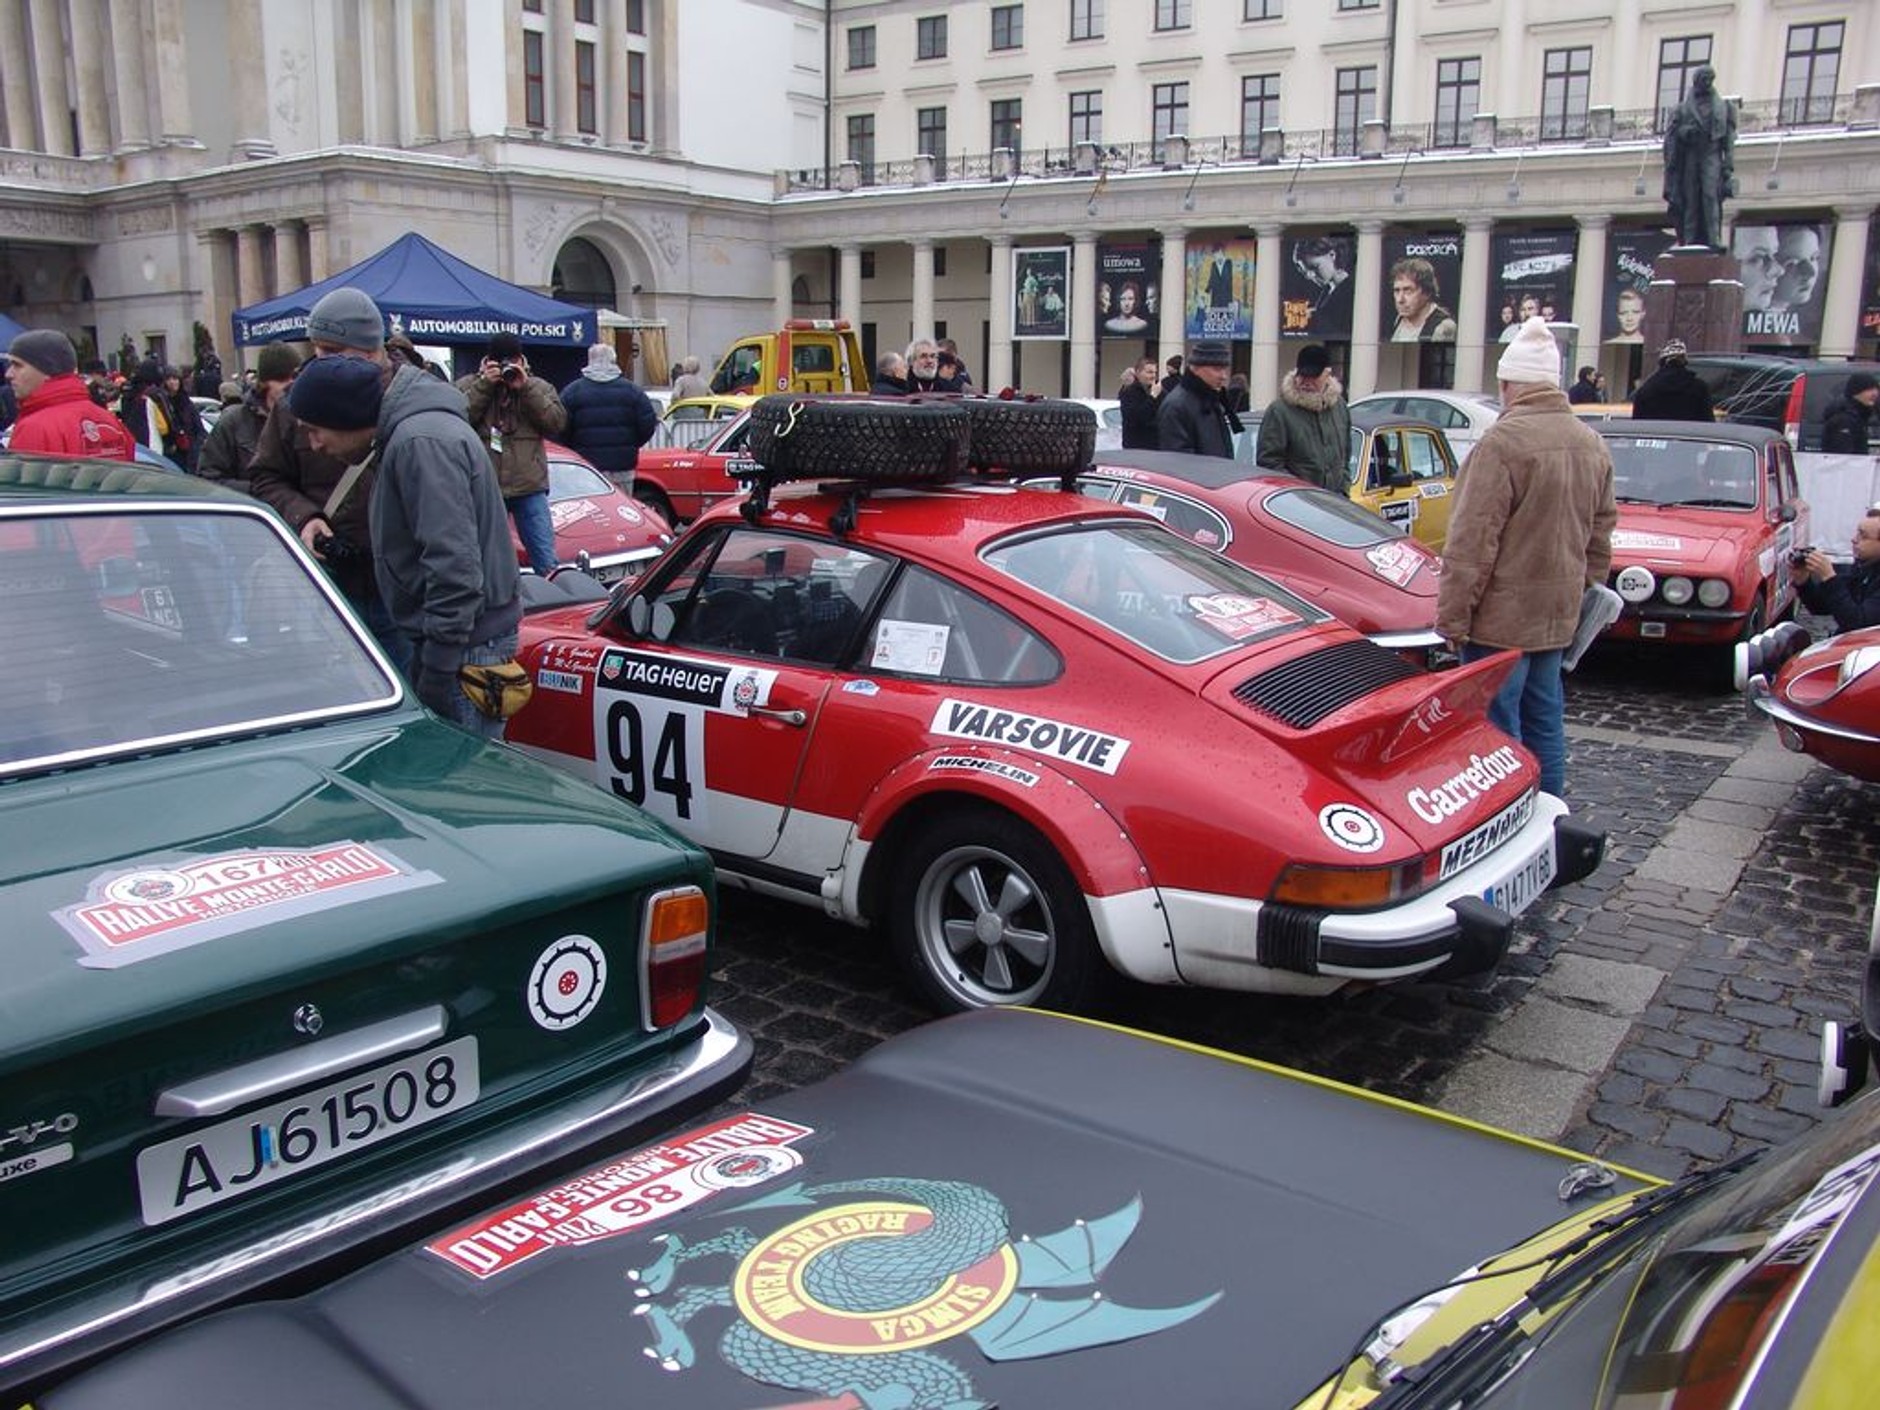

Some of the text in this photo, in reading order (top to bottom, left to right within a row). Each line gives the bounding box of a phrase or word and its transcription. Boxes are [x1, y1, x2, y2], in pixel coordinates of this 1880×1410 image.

[251, 315, 313, 337] AUTOMOBILKL
[409, 319, 566, 338] AUTOMOBILKLUB POLSKI
[1747, 312, 1800, 335] MEWA
[607, 699, 693, 821] 94
[948, 703, 1116, 767] VARSOVIE
[933, 757, 1034, 784] MICHELIN
[1406, 745, 1523, 825] Carrefour
[91, 848, 379, 937] RALLYE MONTE-CARLO
[196, 859, 267, 886] 167
[174, 1054, 457, 1207] AJ 61508
[448, 1117, 796, 1272] RALLYE MONTE-CARLO
[536, 1184, 683, 1246] 86 2011
[751, 1211, 910, 1322] RACING TEAM
[868, 1283, 993, 1342] SIMCA
